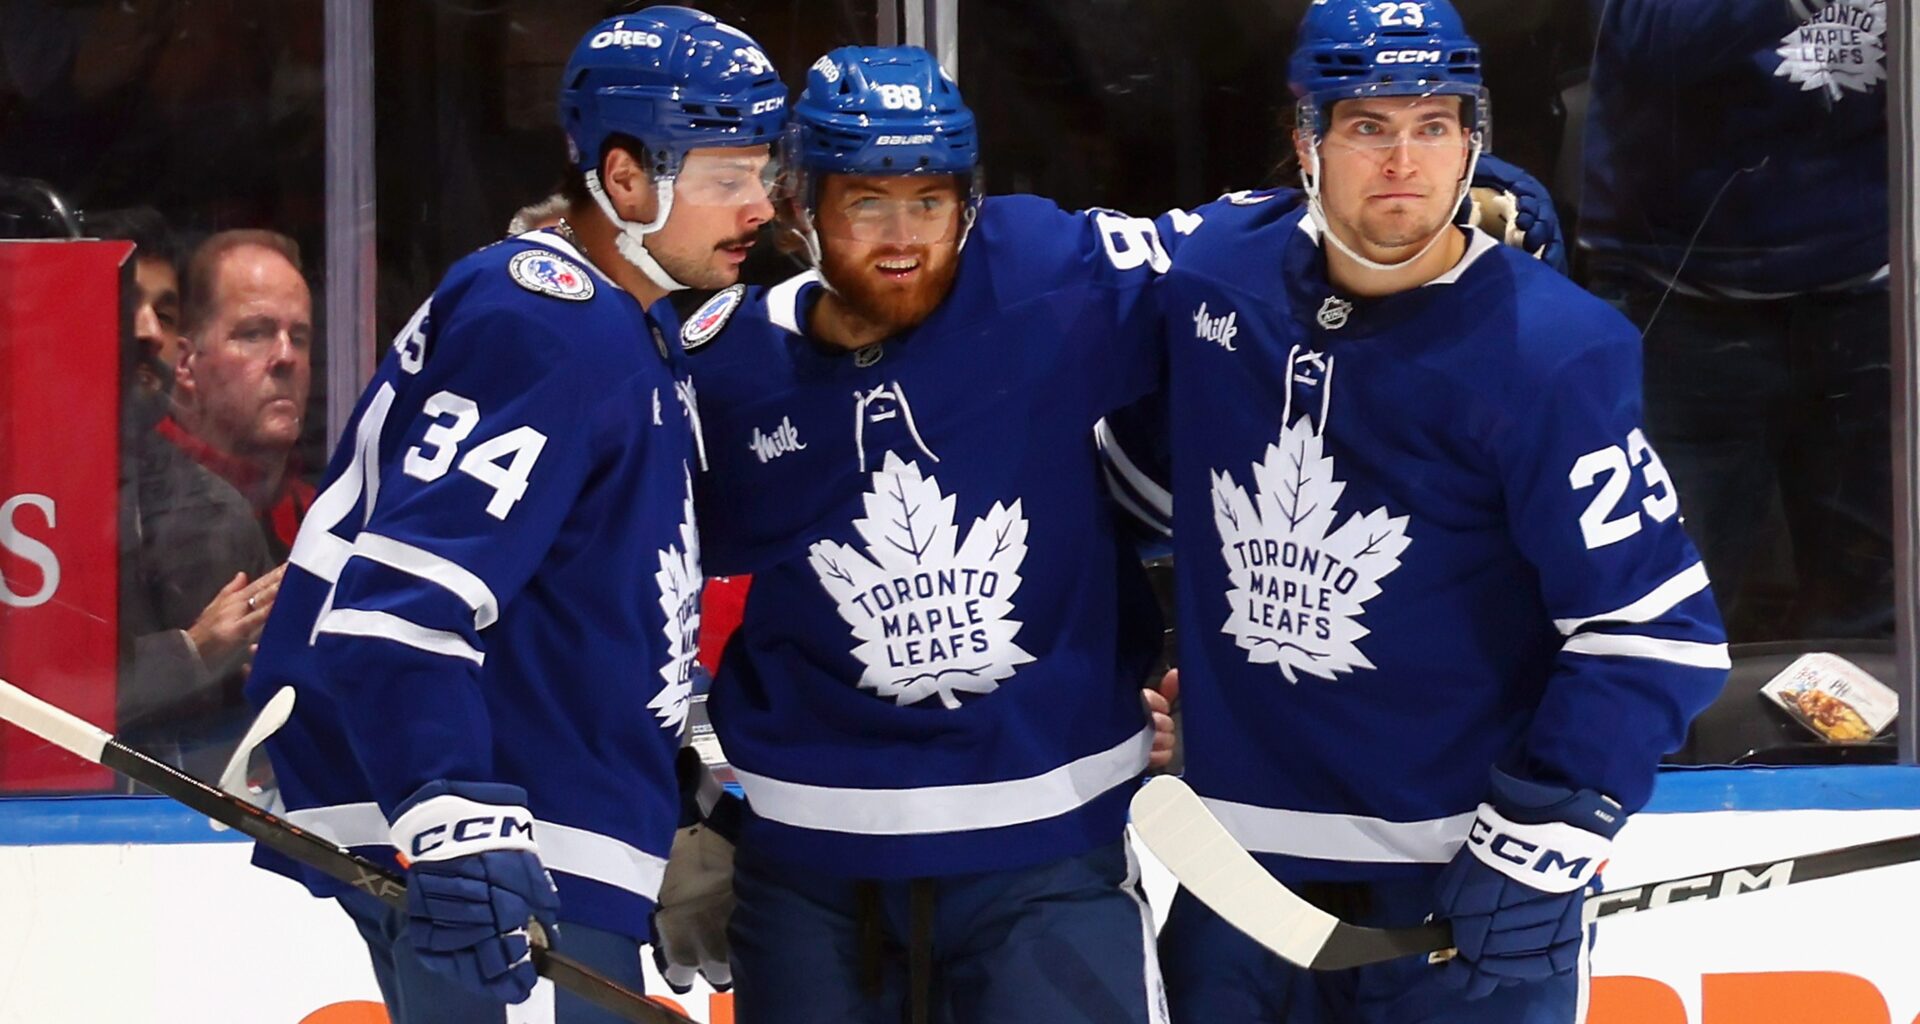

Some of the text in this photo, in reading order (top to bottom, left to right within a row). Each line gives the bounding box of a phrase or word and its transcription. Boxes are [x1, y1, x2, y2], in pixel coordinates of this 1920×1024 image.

[1373, 2, 1425, 28] 23
[1803, 4, 1875, 33] RONTO
[588, 30, 663, 49] OREO
[1375, 50, 1441, 64] CCM
[1801, 29, 1862, 46] MAPLE
[1802, 48, 1864, 65] LEAFS
[812, 55, 840, 83] OREO
[752, 96, 785, 115] CCM
[881, 84, 922, 111] 88
[875, 135, 934, 146] BAUER
[1193, 301, 1238, 352] Milk
[403, 390, 548, 521] 34
[750, 415, 808, 464] Milk
[1568, 427, 1679, 550] 23
[1233, 538, 1359, 596] TORONTO
[852, 568, 999, 619] TORONTO
[1250, 570, 1332, 612] MAPLE
[881, 599, 984, 639] MAPLE
[1249, 599, 1331, 641] LEAFS
[886, 628, 990, 668] LEAFS
[412, 816, 534, 857] CCM
[1468, 816, 1592, 880] CCM
[1581, 860, 1795, 925] CCM
